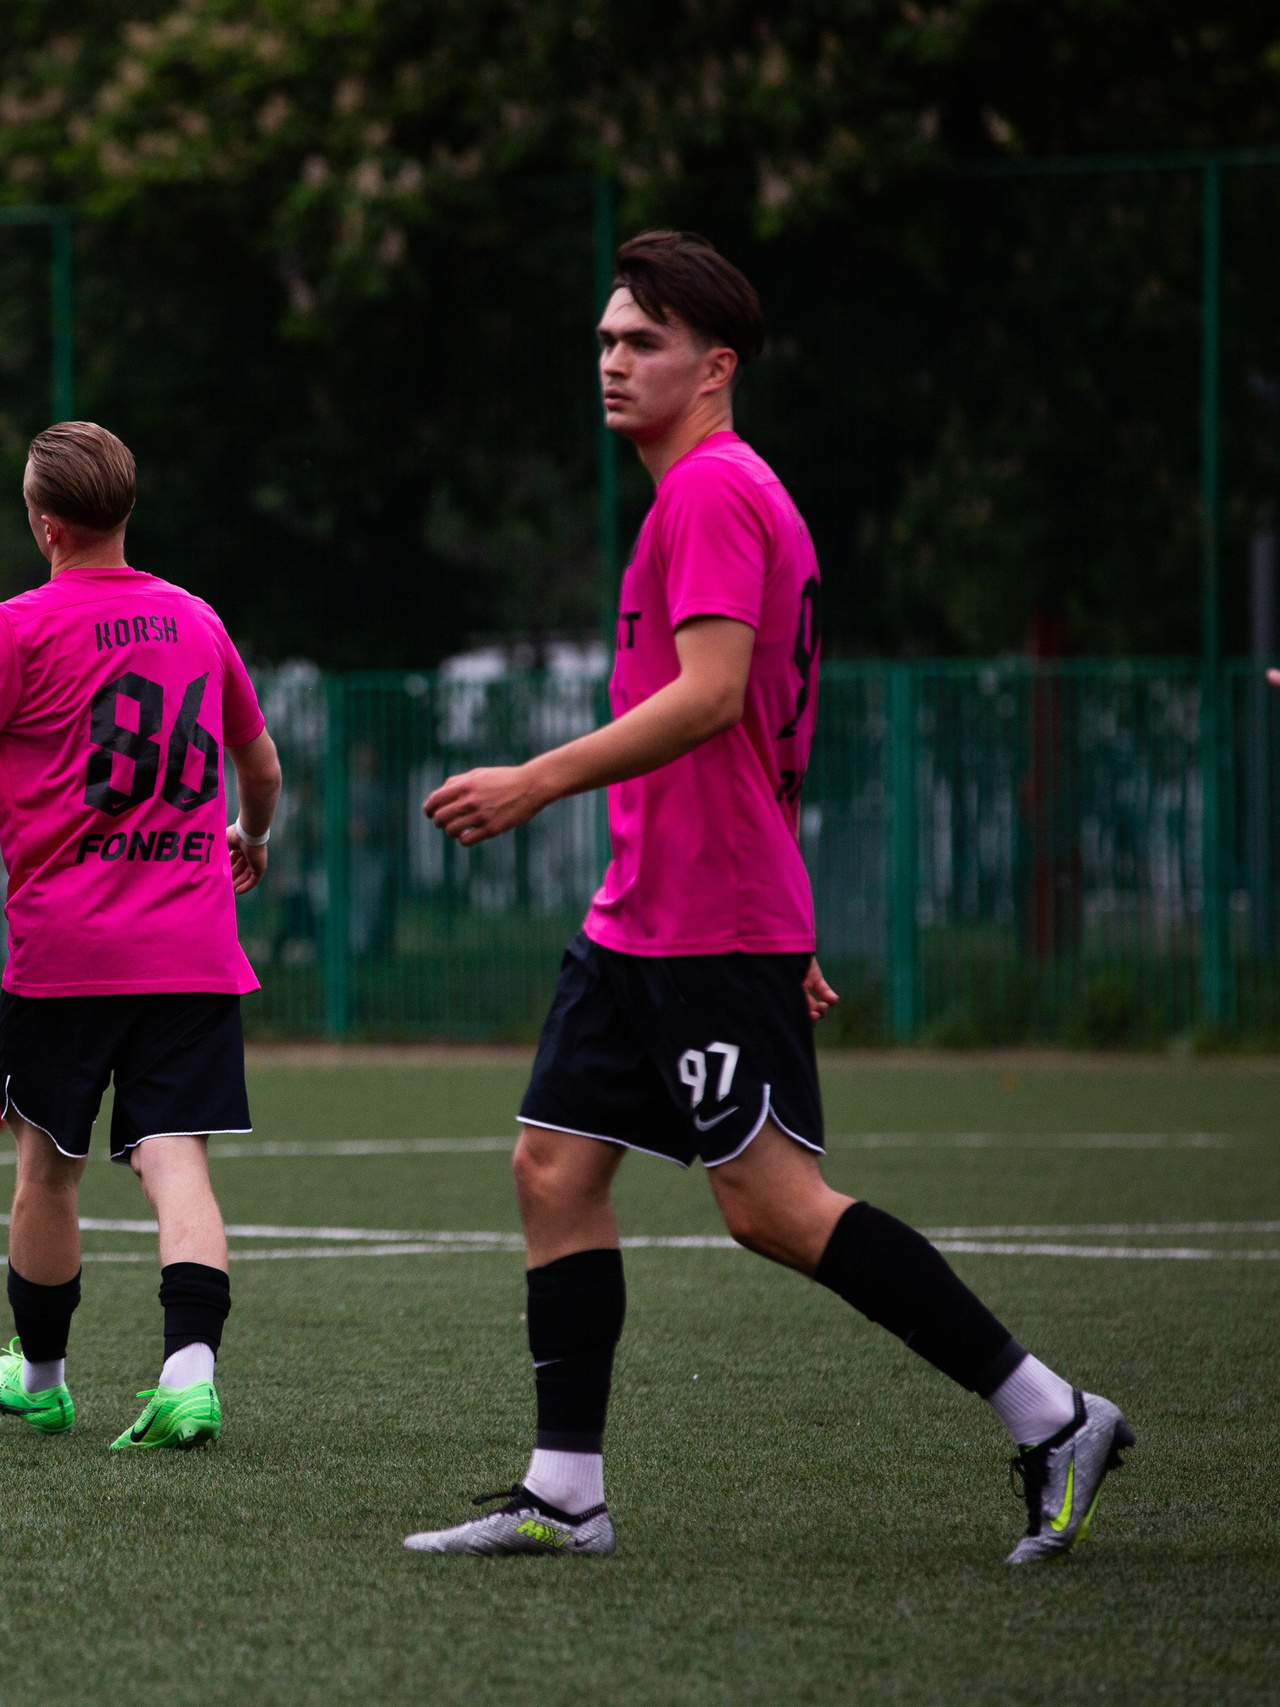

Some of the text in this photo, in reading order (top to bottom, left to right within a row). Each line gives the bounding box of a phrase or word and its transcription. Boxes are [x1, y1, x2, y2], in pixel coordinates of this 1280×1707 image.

[95, 615, 178, 652] KORSH
[84, 670, 219, 818] 86
[75, 830, 215, 864] FONBET
[678, 1041, 740, 1109] 97
